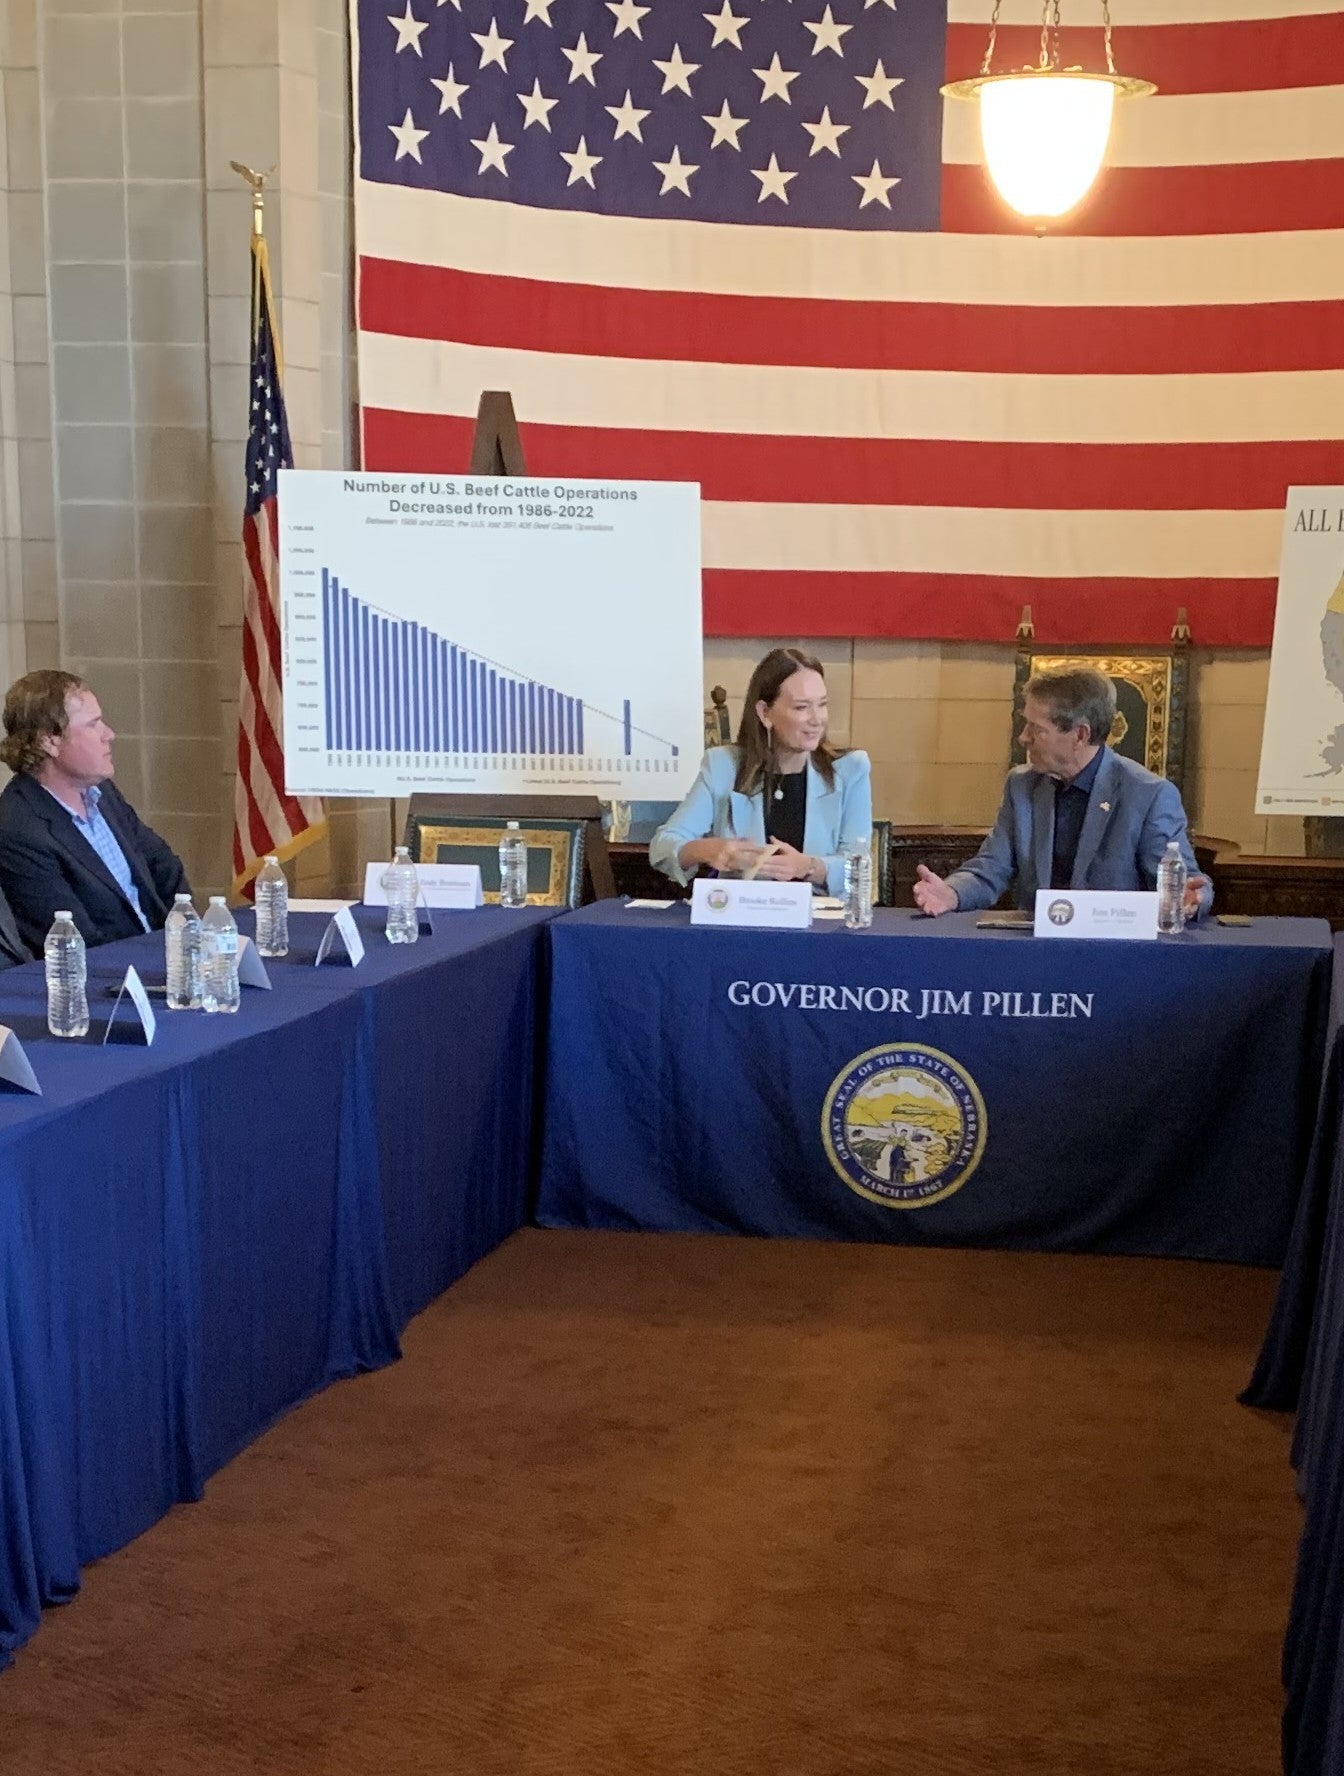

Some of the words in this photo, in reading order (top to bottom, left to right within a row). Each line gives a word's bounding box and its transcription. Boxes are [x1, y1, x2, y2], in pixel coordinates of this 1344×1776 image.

[343, 479, 406, 494] Number
[410, 481, 425, 494] of
[429, 482, 461, 495] U.S.
[464, 483, 499, 496] Beef
[503, 484, 550, 498] Cattle
[554, 486, 638, 501] Operations
[389, 500, 473, 514] Decreased
[477, 502, 513, 516] from
[518, 504, 594, 518] 1986-2022
[1293, 508, 1332, 532] ALL
[728, 980, 912, 1013] GOVERNOR
[916, 989, 973, 1019] JIM
[981, 991, 1095, 1019] PILLEN
[835, 1078, 858, 1109] SEAL
[858, 1062, 874, 1077] OF
[876, 1053, 904, 1065] THE
[909, 1054, 952, 1077] STATE
[949, 1075, 965, 1091] OF
[859, 1174, 900, 1198] MARCH
